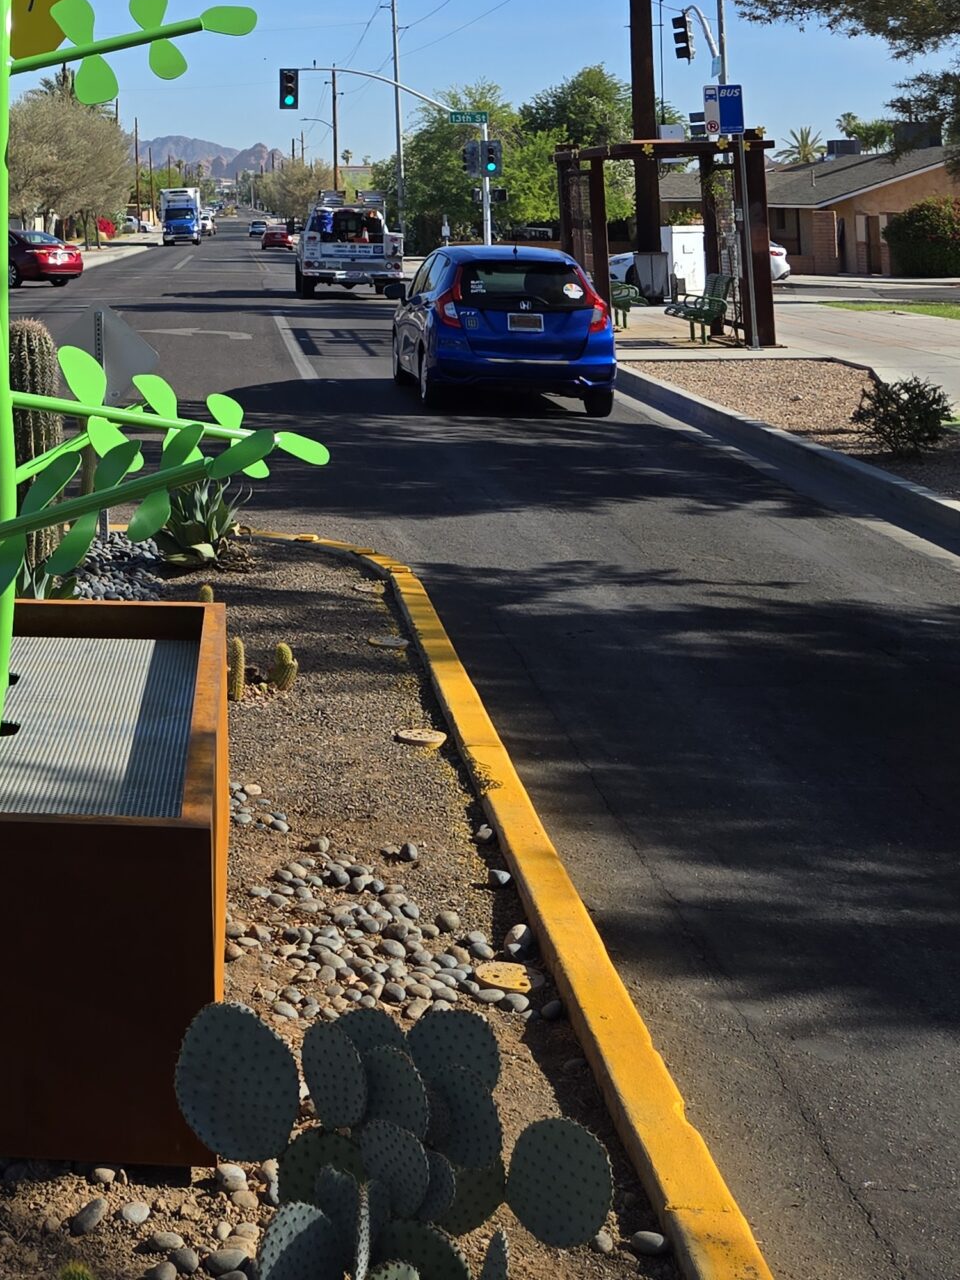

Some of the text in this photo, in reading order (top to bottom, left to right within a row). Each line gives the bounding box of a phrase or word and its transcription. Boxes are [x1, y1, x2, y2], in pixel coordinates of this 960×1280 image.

[720, 88, 740, 97] BUS
[452, 114, 486, 122] 13th St
